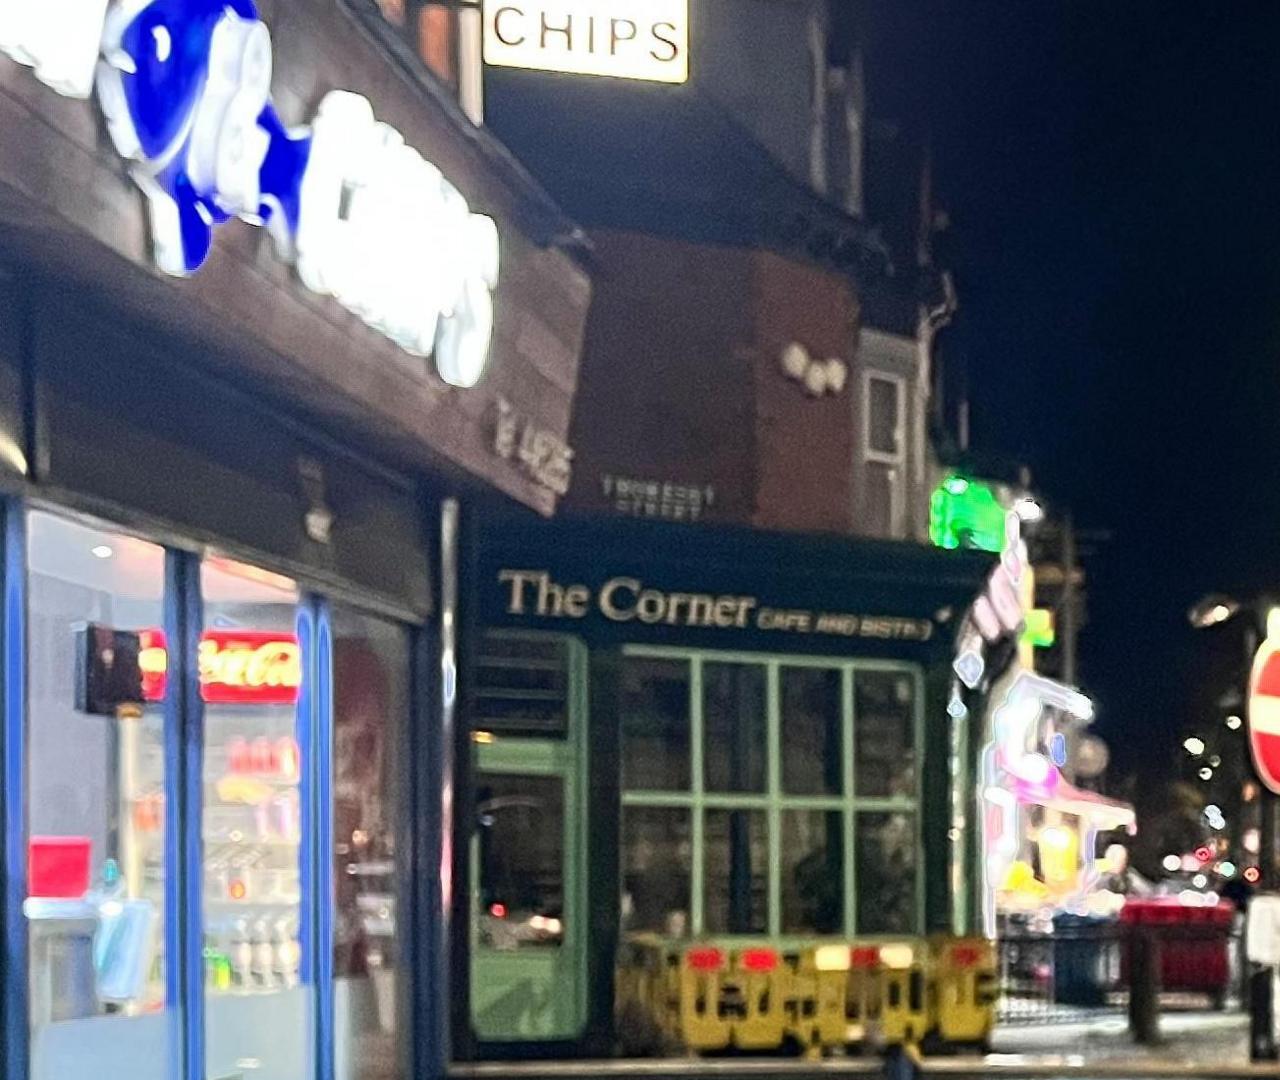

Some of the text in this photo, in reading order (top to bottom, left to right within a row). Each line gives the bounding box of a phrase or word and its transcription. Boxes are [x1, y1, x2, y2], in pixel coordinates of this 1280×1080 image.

[494, 6, 679, 62] CHIPS
[498, 568, 591, 618] The
[599, 576, 756, 628] Corner
